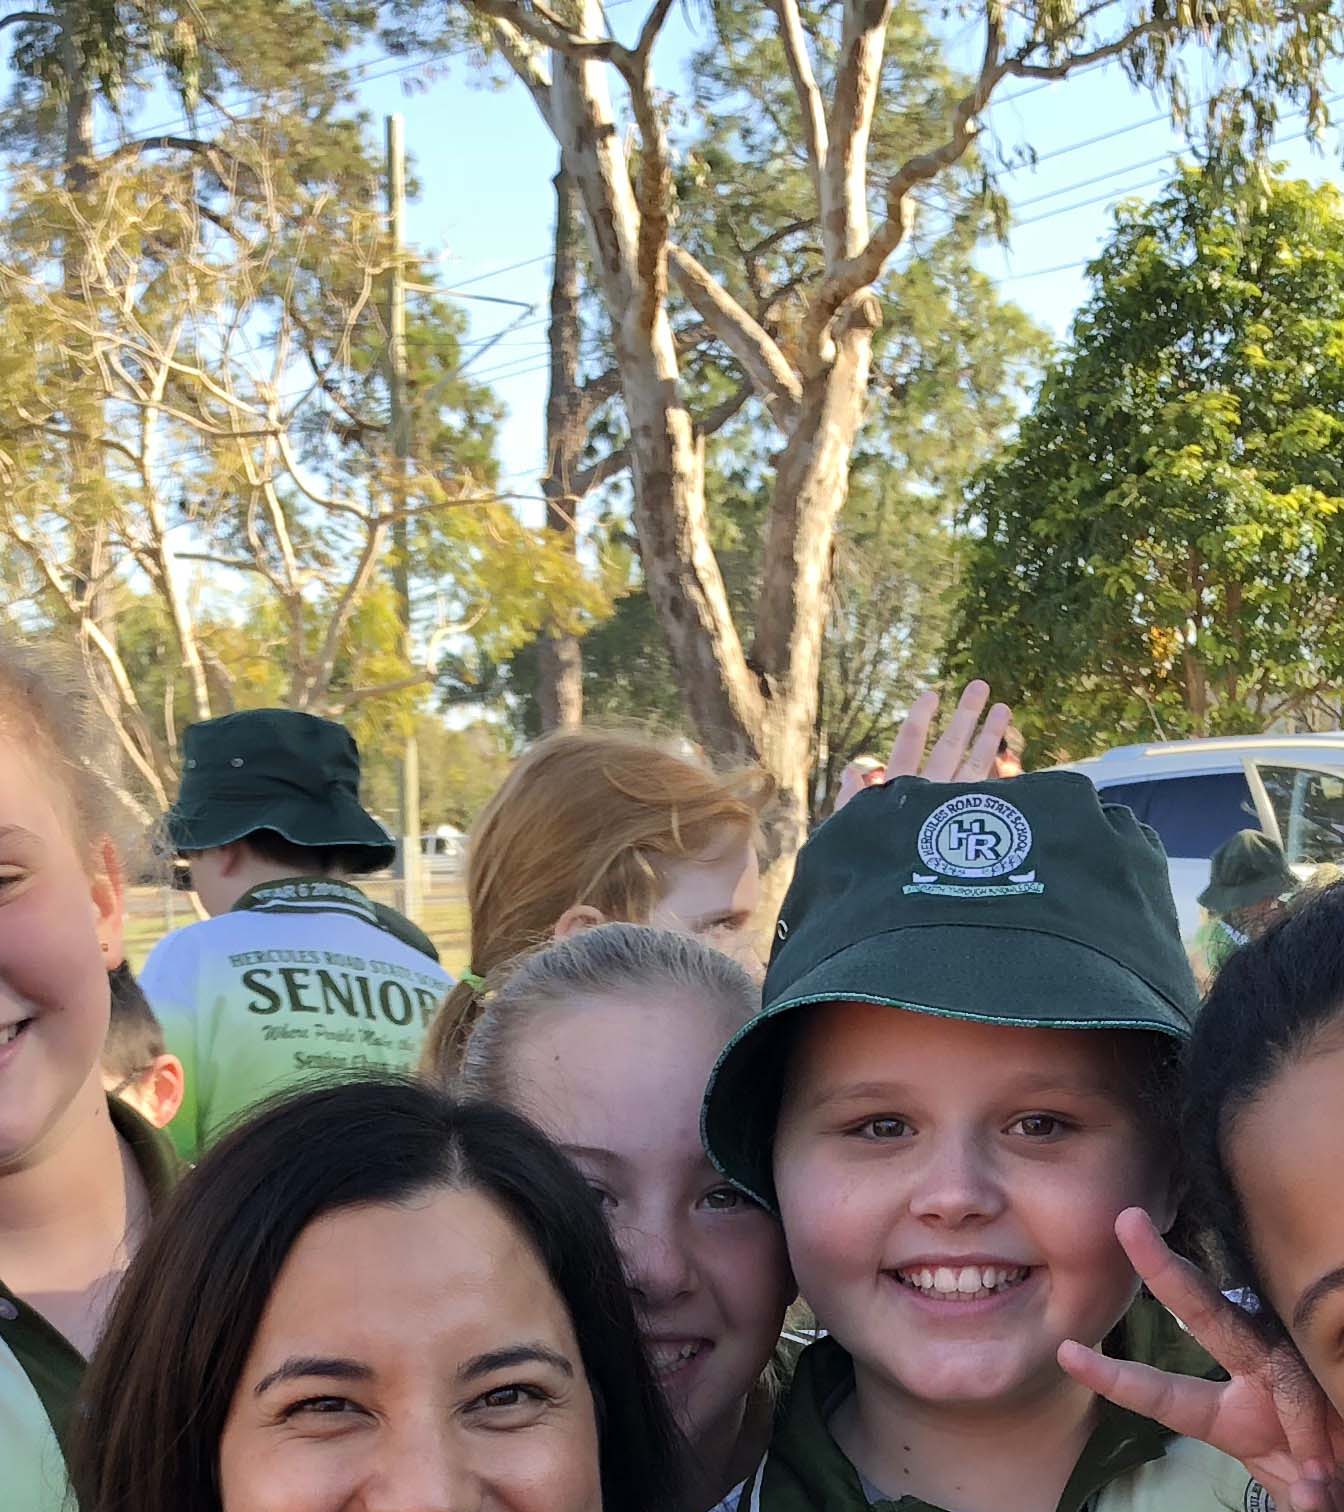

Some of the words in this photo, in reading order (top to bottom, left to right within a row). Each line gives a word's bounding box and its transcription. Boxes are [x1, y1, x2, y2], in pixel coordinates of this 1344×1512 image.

[920, 809, 950, 857] HERCULES
[946, 797, 983, 815] ROAD
[983, 797, 1016, 819] STATE
[1010, 815, 1028, 856] SCHOOL
[948, 818, 1002, 861] HR
